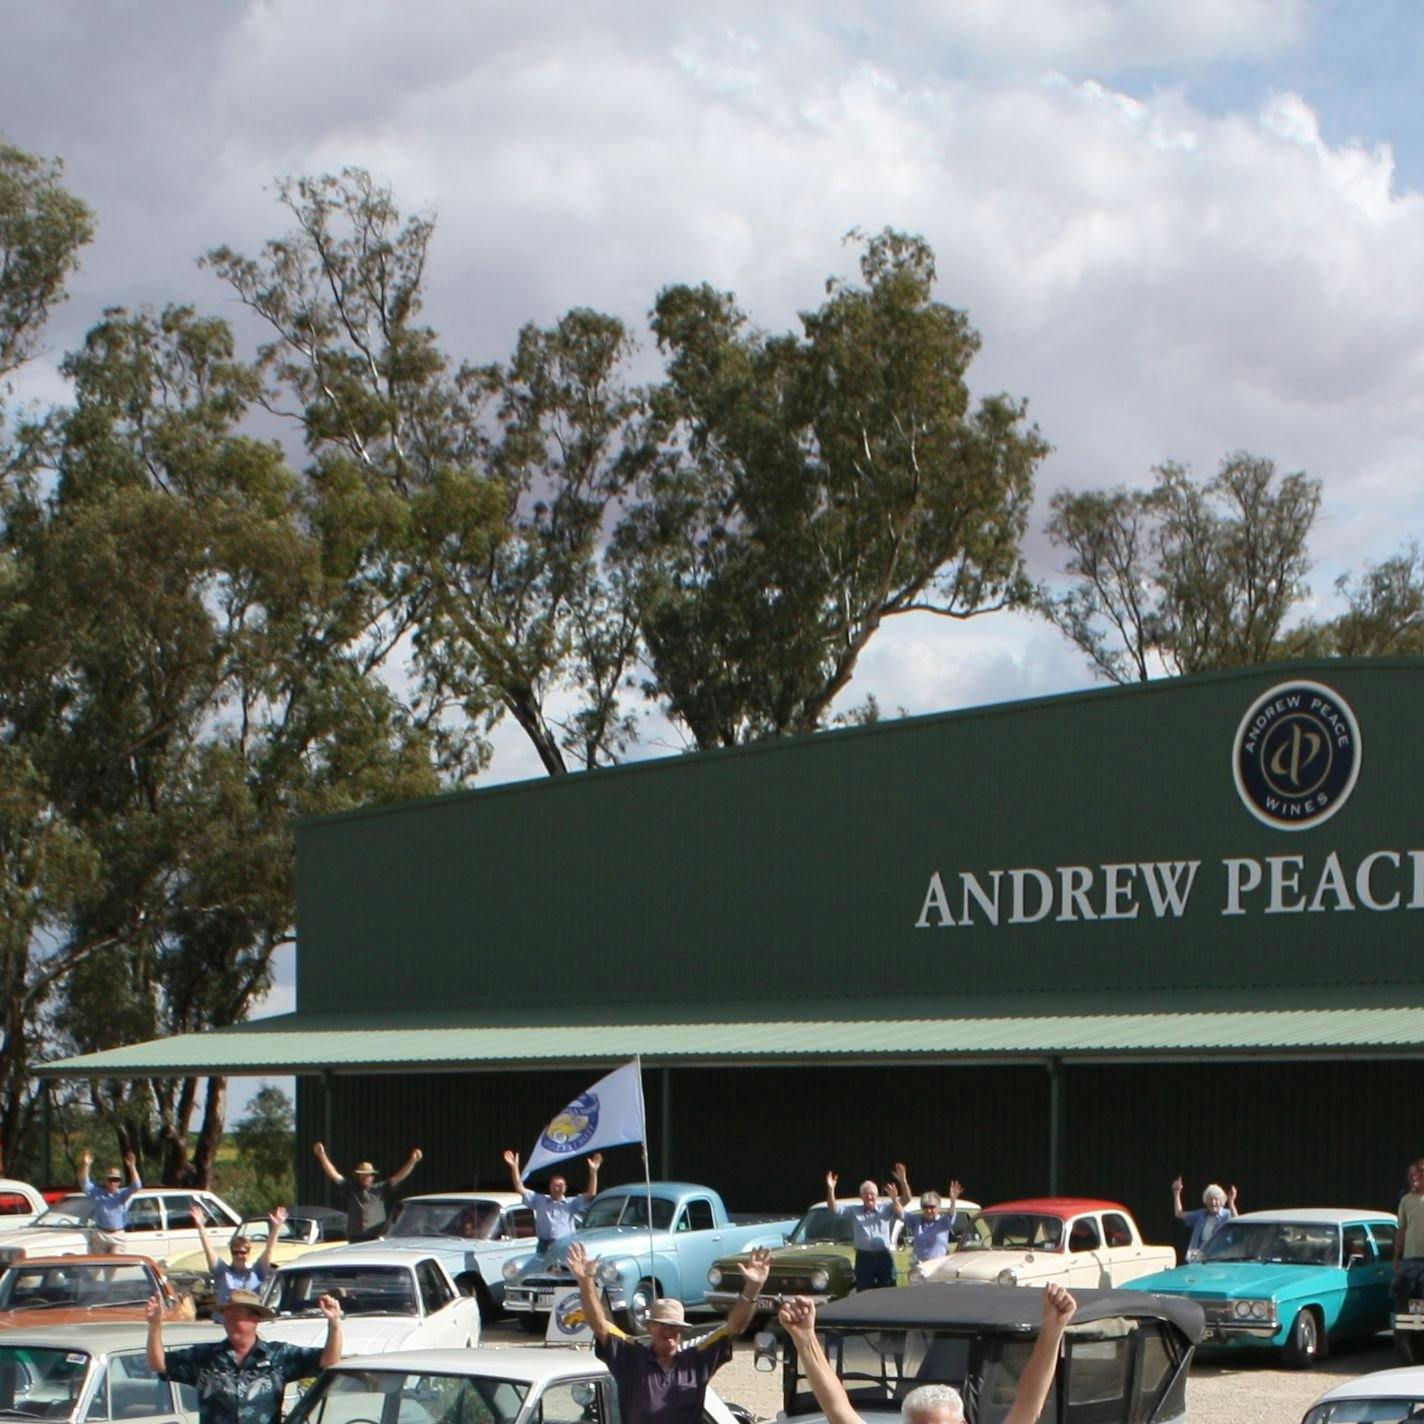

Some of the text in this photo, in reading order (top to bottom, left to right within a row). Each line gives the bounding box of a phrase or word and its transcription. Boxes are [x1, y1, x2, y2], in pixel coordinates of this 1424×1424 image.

[1245, 696, 1349, 754] ANDREW PEACE
[1266, 792, 1329, 816] WINES
[914, 859, 1201, 928] ANDREW
